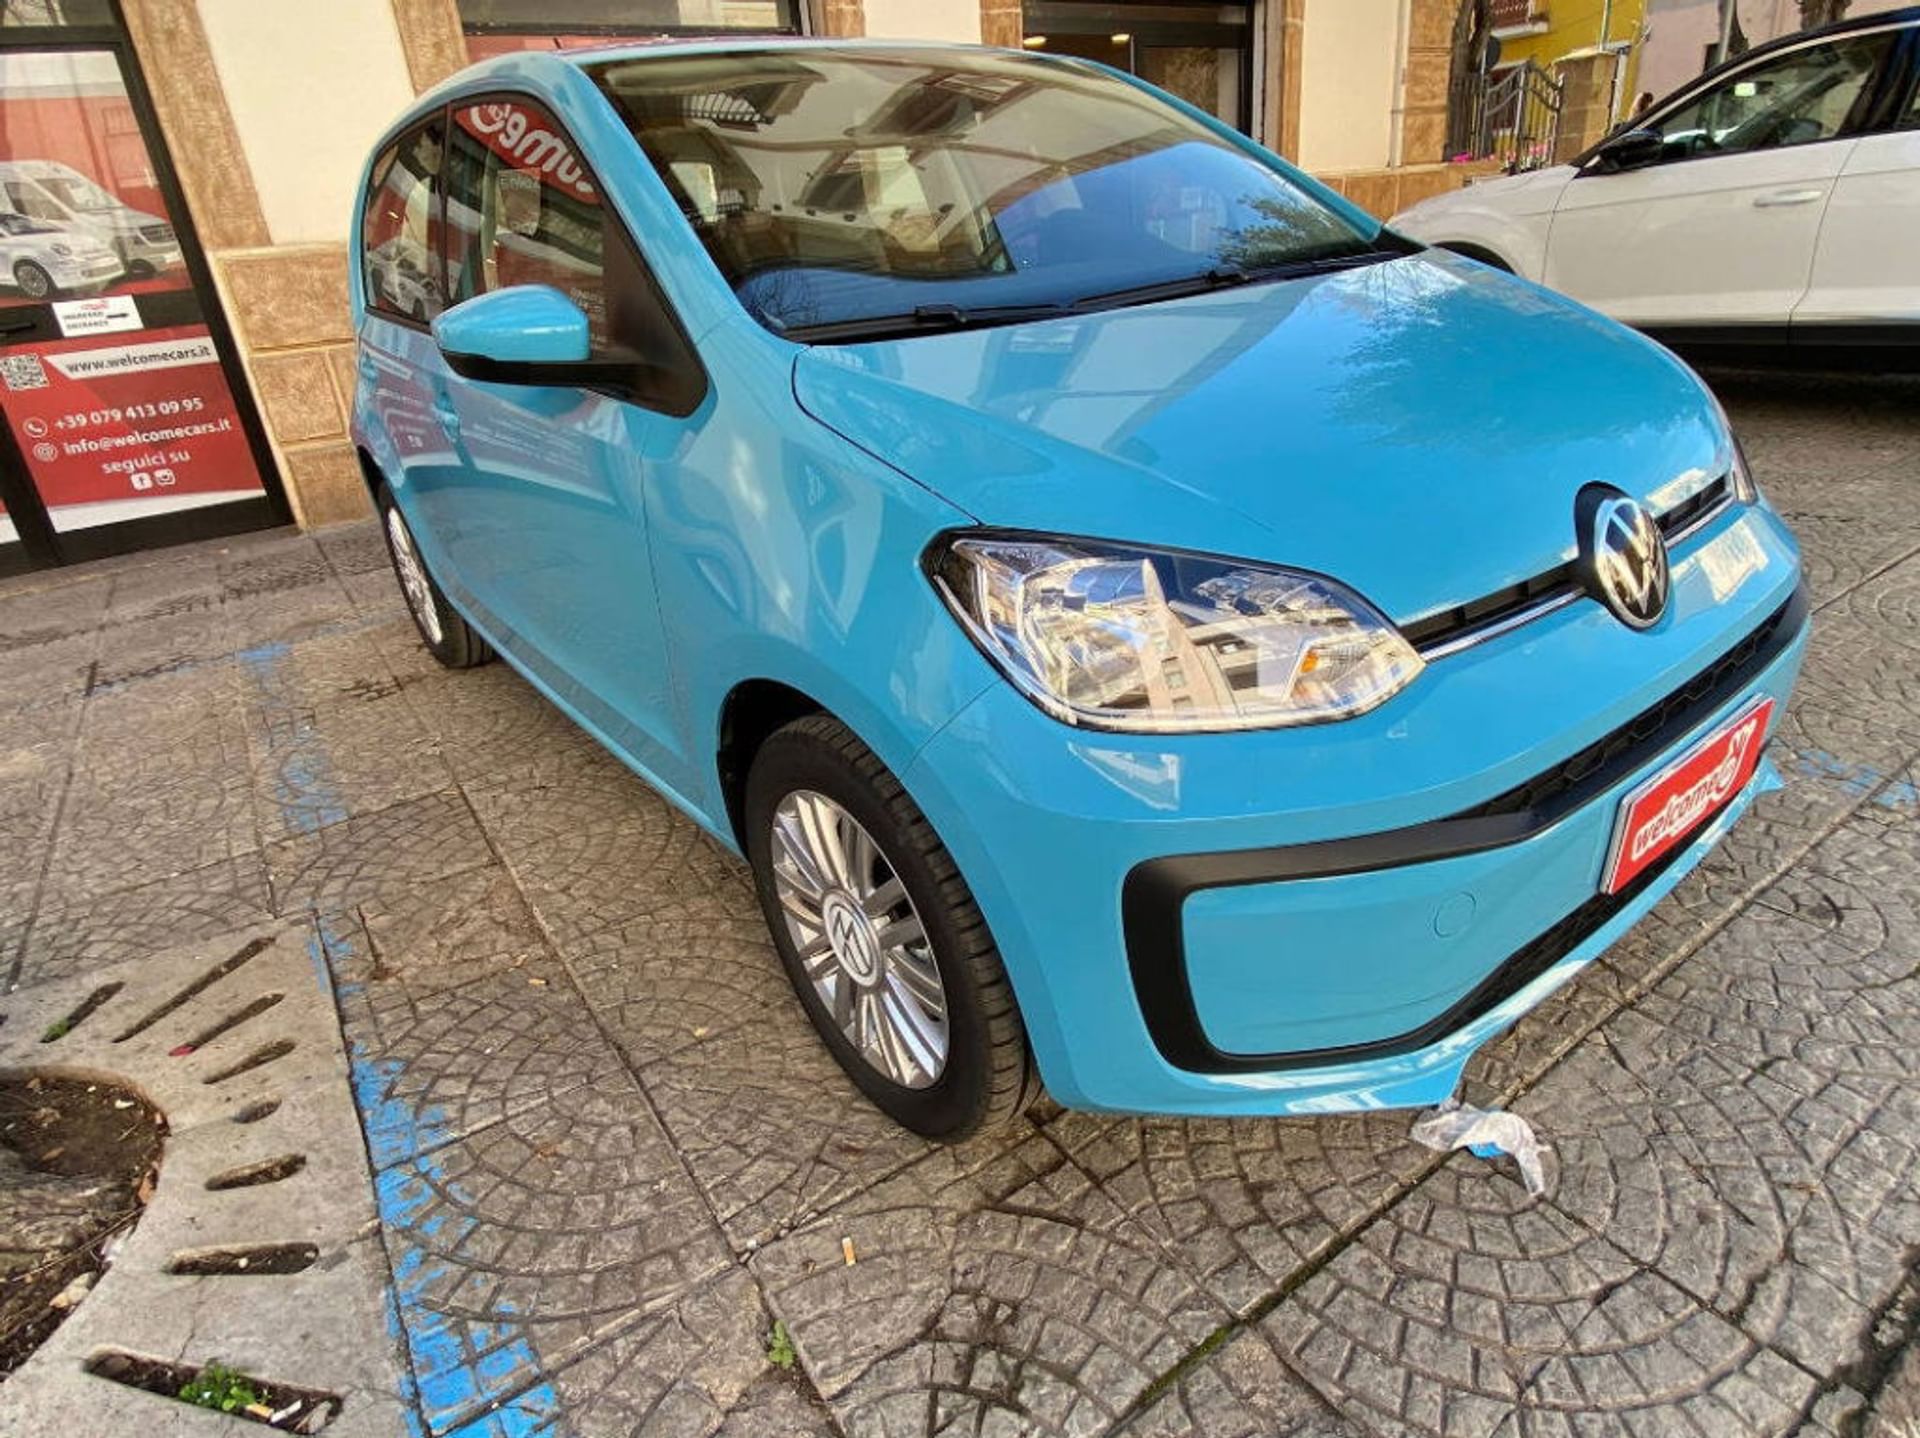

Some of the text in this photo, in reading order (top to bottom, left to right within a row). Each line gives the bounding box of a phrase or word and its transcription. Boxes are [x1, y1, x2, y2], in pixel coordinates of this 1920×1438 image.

[66, 345, 211, 374] www.welcomecars.it
[54, 396, 204, 431] +39 079 413 09 95
[64, 418, 232, 455] info@welcomecars.it
[102, 449, 191, 474] seguici su
